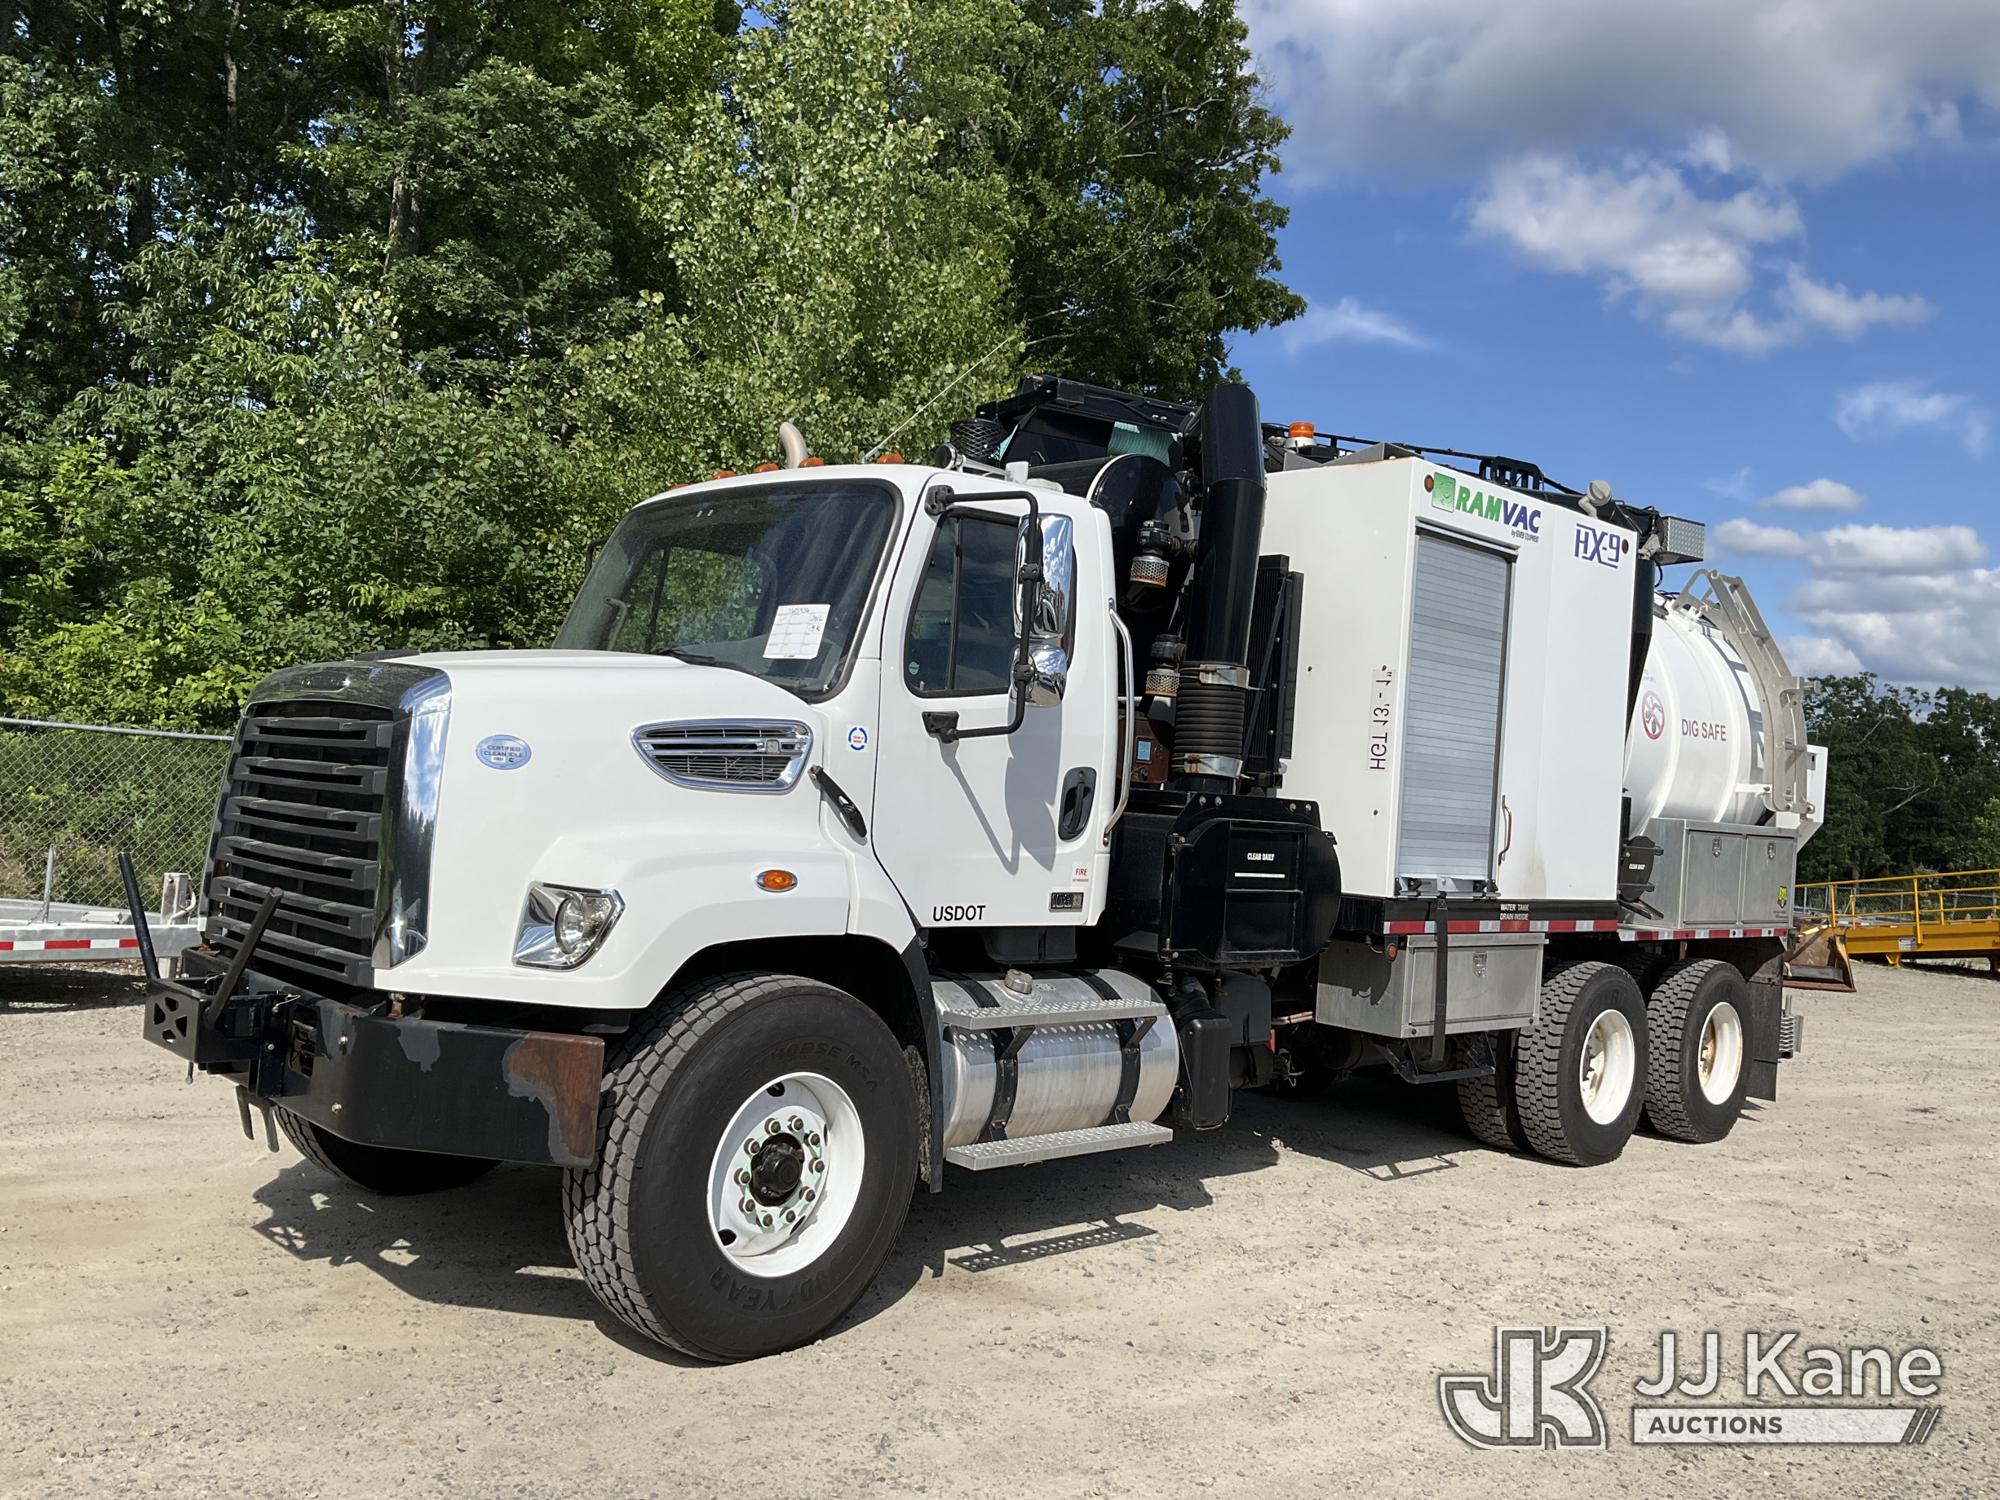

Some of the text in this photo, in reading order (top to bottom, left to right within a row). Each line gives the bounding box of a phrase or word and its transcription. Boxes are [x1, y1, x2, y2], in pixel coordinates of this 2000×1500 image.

[1456, 485, 1542, 533] RAMVAC
[1574, 523, 1621, 569] HX-9
[1681, 718, 1727, 742] DIG SAFE
[1247, 852, 1261, 861] CLEAN
[1075, 867, 1088, 877] FIRE
[932, 905, 986, 922] USDOT
